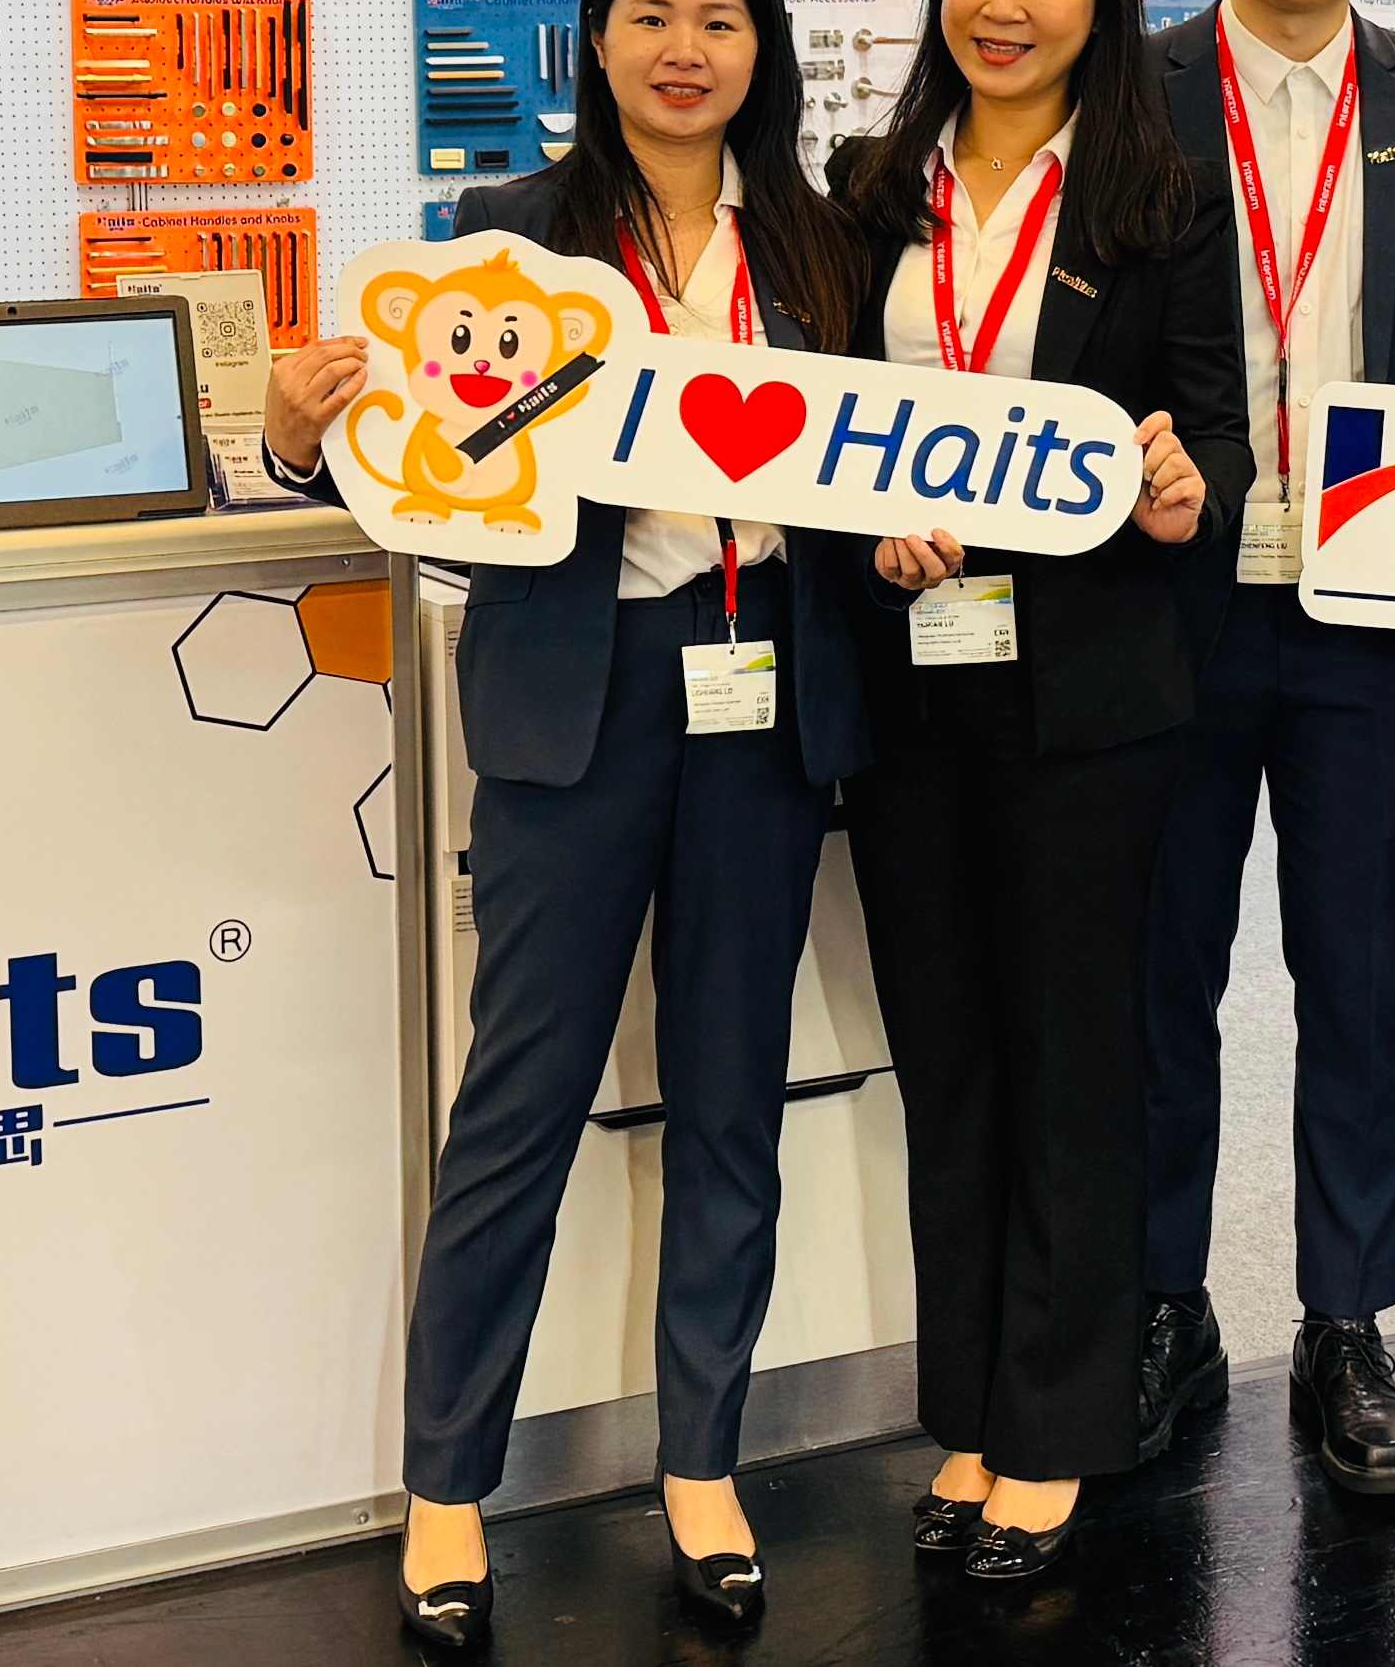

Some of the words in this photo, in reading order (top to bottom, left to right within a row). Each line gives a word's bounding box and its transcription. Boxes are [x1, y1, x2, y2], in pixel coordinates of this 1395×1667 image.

[1336, 81, 1354, 129] interzum
[1241, 160, 1259, 211] interzum
[1316, 164, 1336, 214] interzum
[142, 216, 187, 227] Cabinet
[190, 215, 238, 227] Handles
[241, 214, 263, 225] and
[266, 213, 301, 224] Knobs
[1260, 249, 1277, 301] interzum
[737, 296, 749, 342] nterzum
[613, 368, 656, 464] I
[816, 390, 1117, 517] Haits
